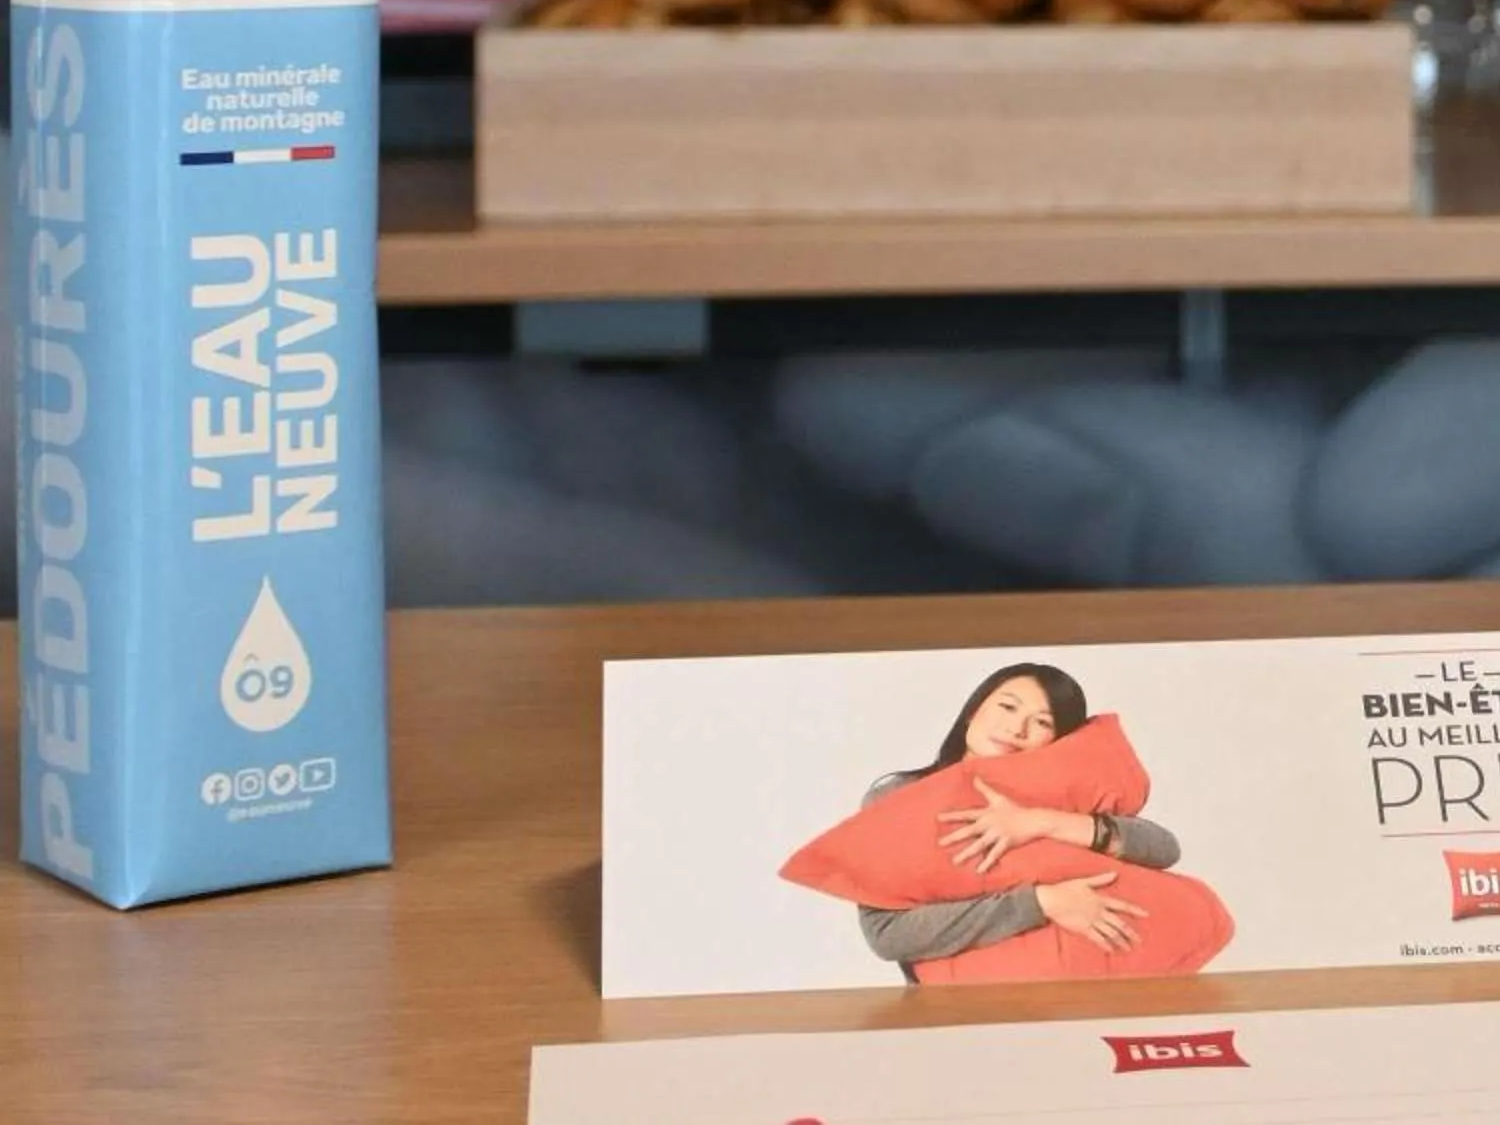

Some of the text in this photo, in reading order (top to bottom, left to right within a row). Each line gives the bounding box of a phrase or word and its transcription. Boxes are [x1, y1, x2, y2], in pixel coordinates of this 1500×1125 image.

[180, 64, 342, 90] Eau minérale
[206, 86, 320, 111] naturelle
[181, 109, 346, 134] de montagne
[191, 234, 272, 542] L'EAU
[274, 228, 339, 534] NEUVE
[1441, 660, 1478, 682] LE
[1367, 726, 1408, 749] AU
[1399, 943, 1464, 957] ibis.com
[1127, 1042, 1224, 1062] ibis
